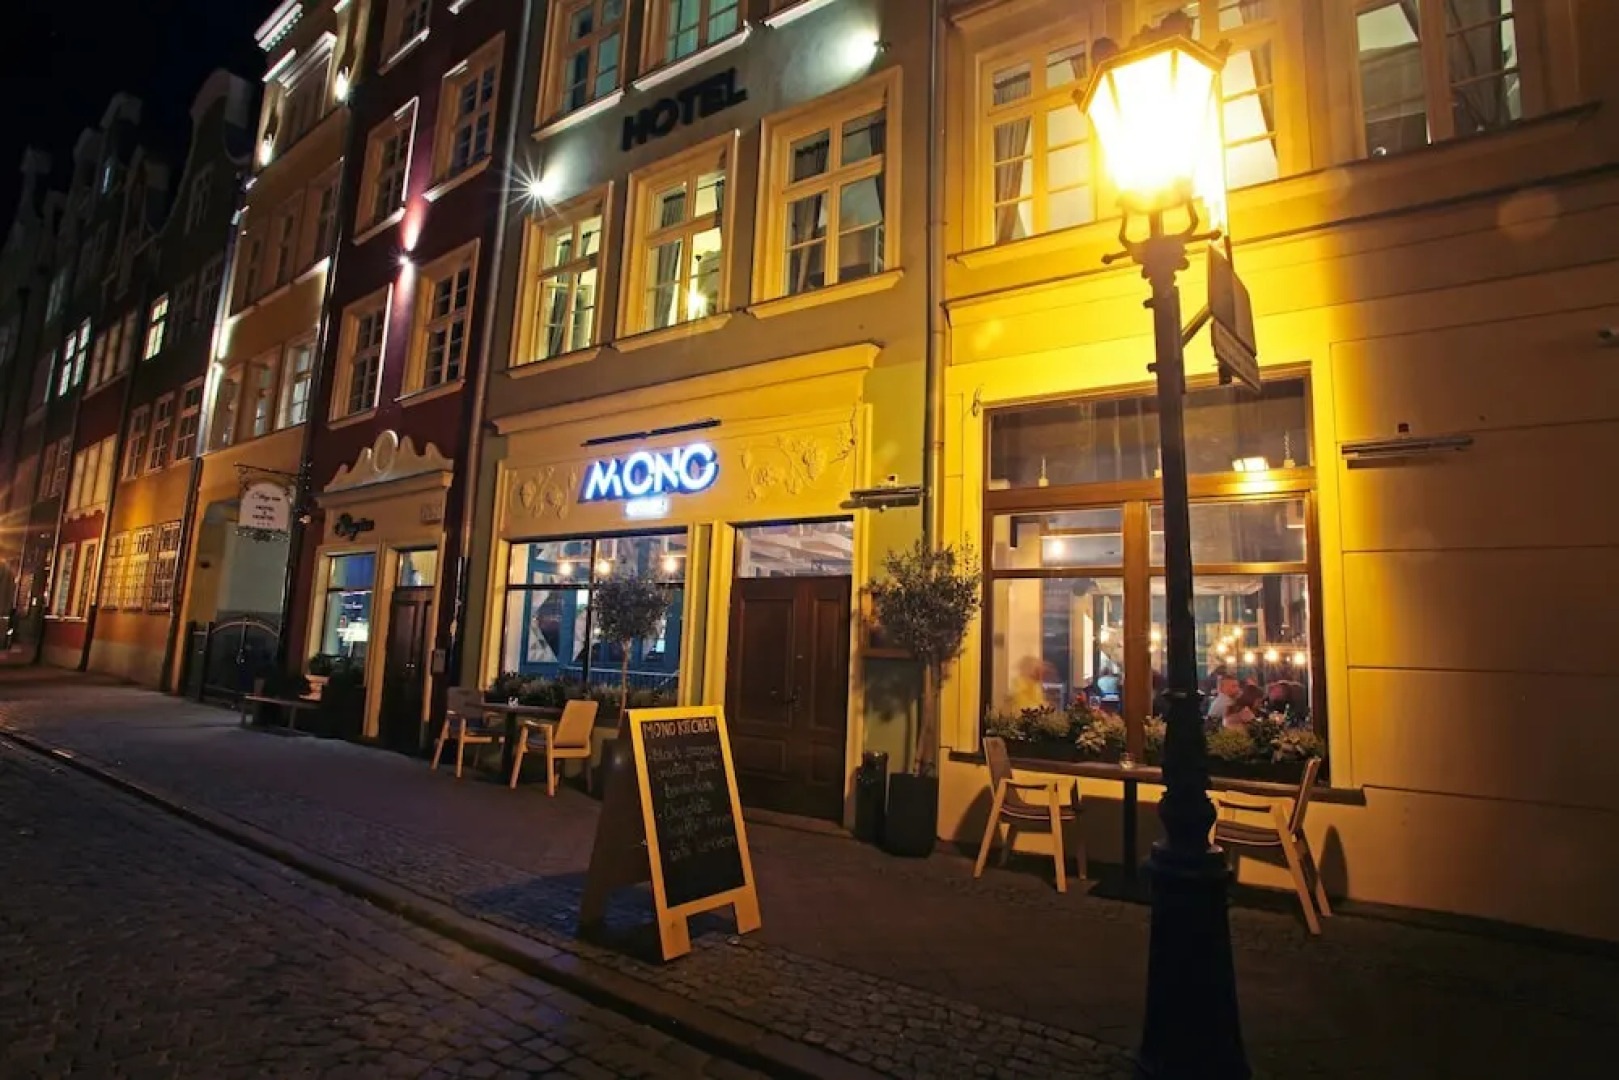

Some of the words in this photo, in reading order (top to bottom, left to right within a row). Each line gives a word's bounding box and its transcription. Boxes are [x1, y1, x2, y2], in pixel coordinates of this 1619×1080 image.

[622, 67, 748, 151] HOTEL
[582, 442, 718, 501] MONO
[642, 721, 676, 739] MONO
[676, 718, 717, 736] KITCHEN
